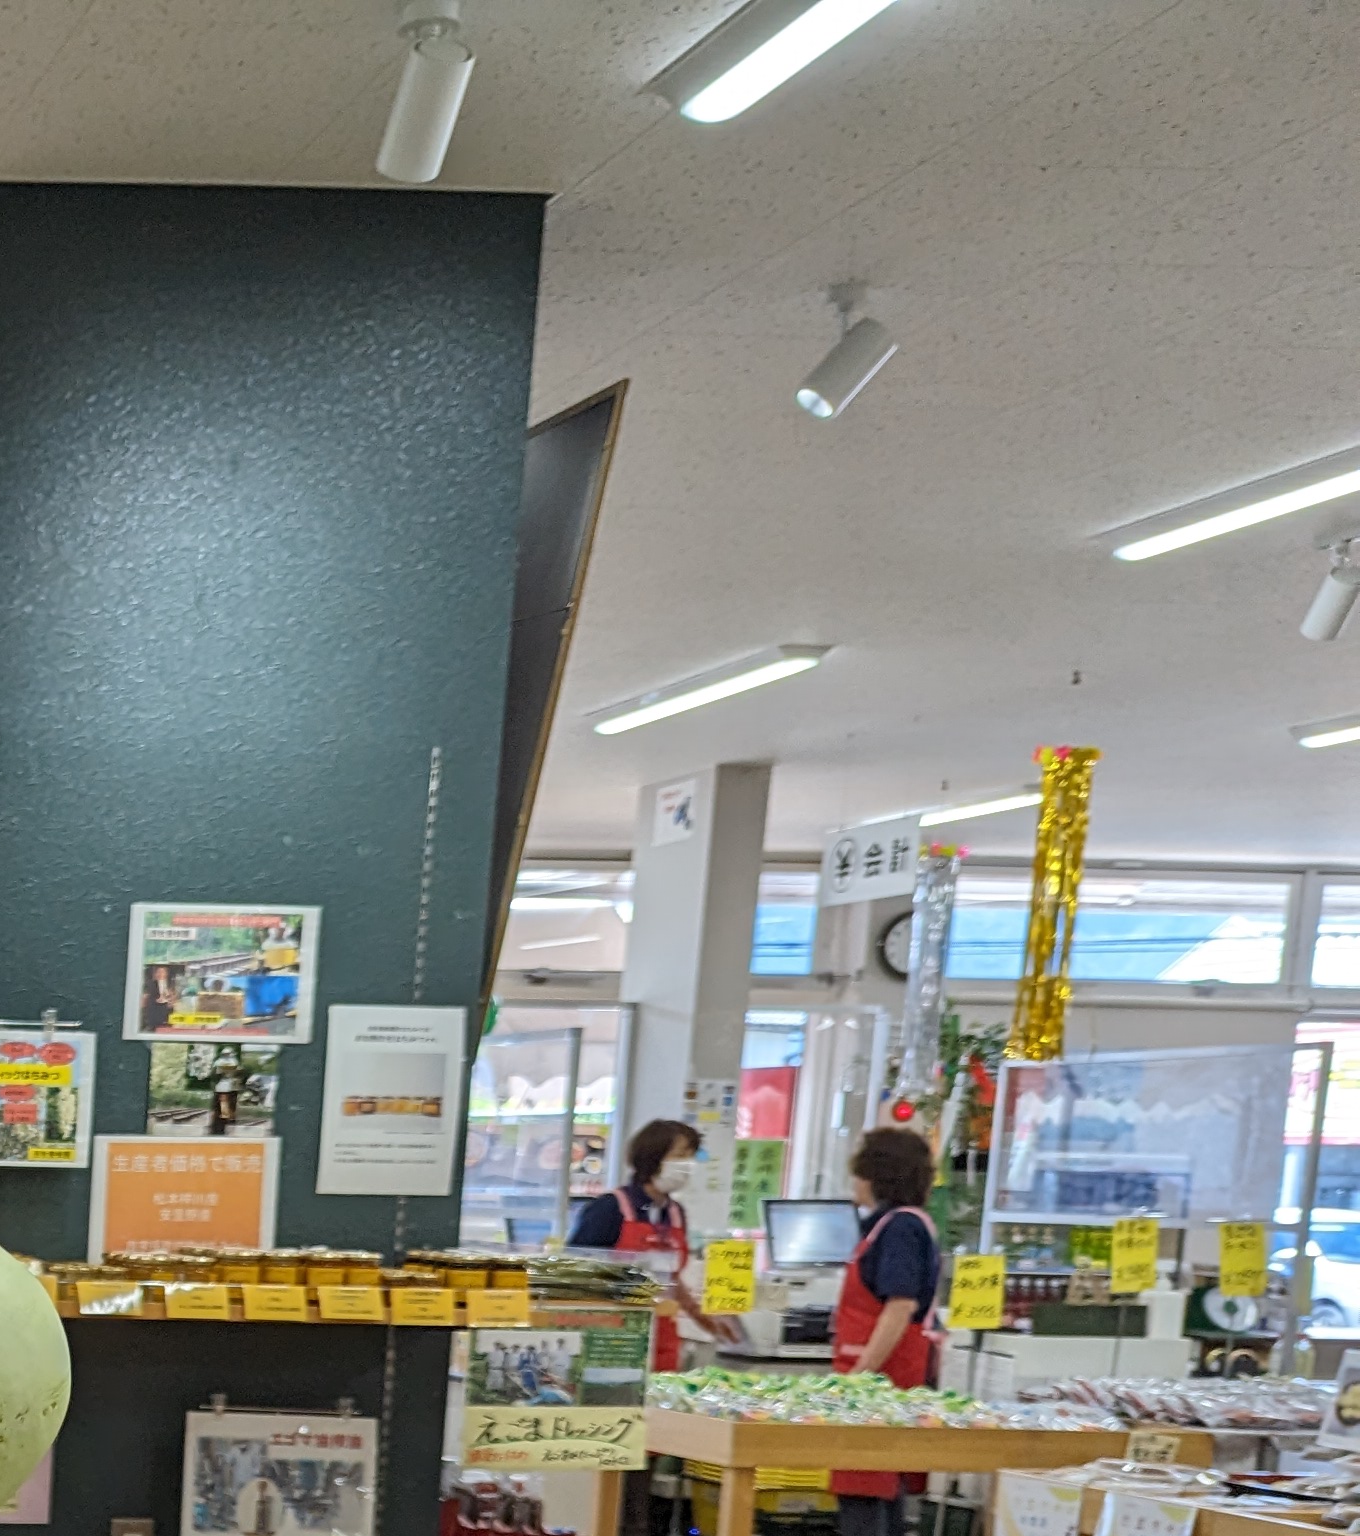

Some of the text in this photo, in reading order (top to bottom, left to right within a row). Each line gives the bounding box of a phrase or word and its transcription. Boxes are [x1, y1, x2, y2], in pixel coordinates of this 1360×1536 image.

[112, 1154, 263, 1173] 生産者価格で販売
